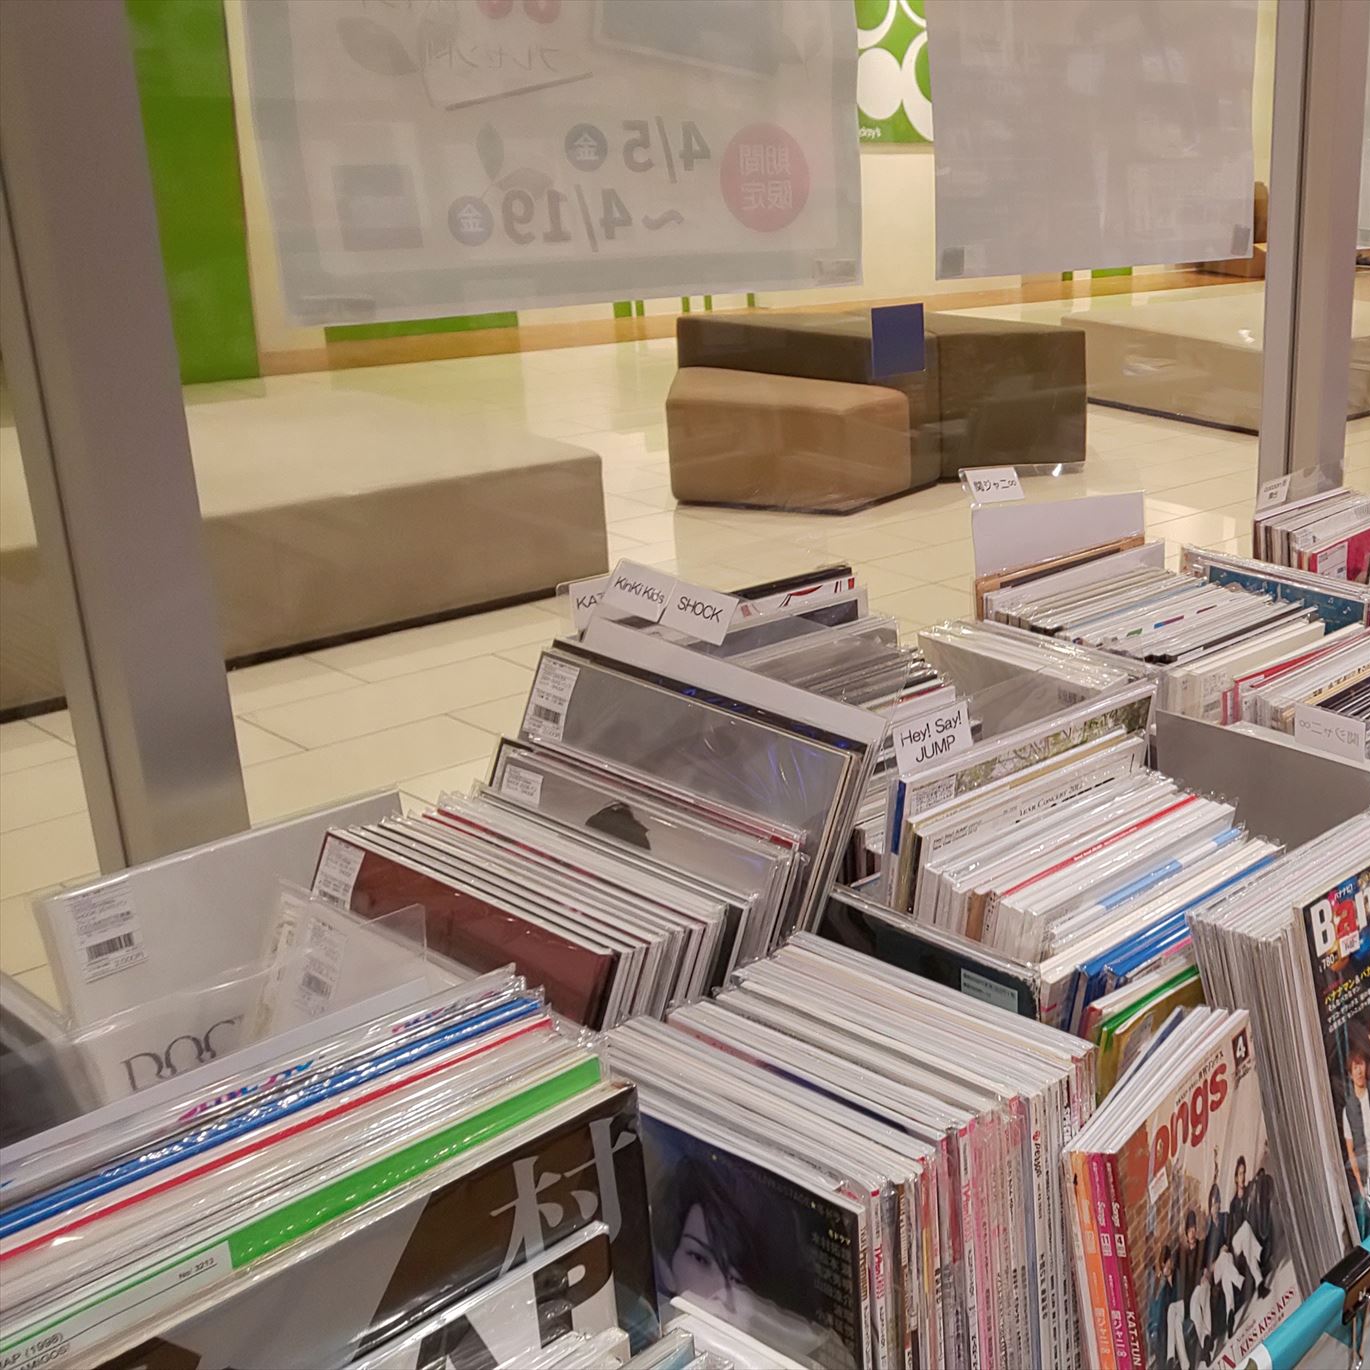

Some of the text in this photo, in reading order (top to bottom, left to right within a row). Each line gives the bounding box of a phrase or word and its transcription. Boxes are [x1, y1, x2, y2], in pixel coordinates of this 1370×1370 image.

[677, 593, 724, 623] SHOCK
[900, 712, 964, 748] Hey! Say!
[915, 735, 957, 764] JUMP
